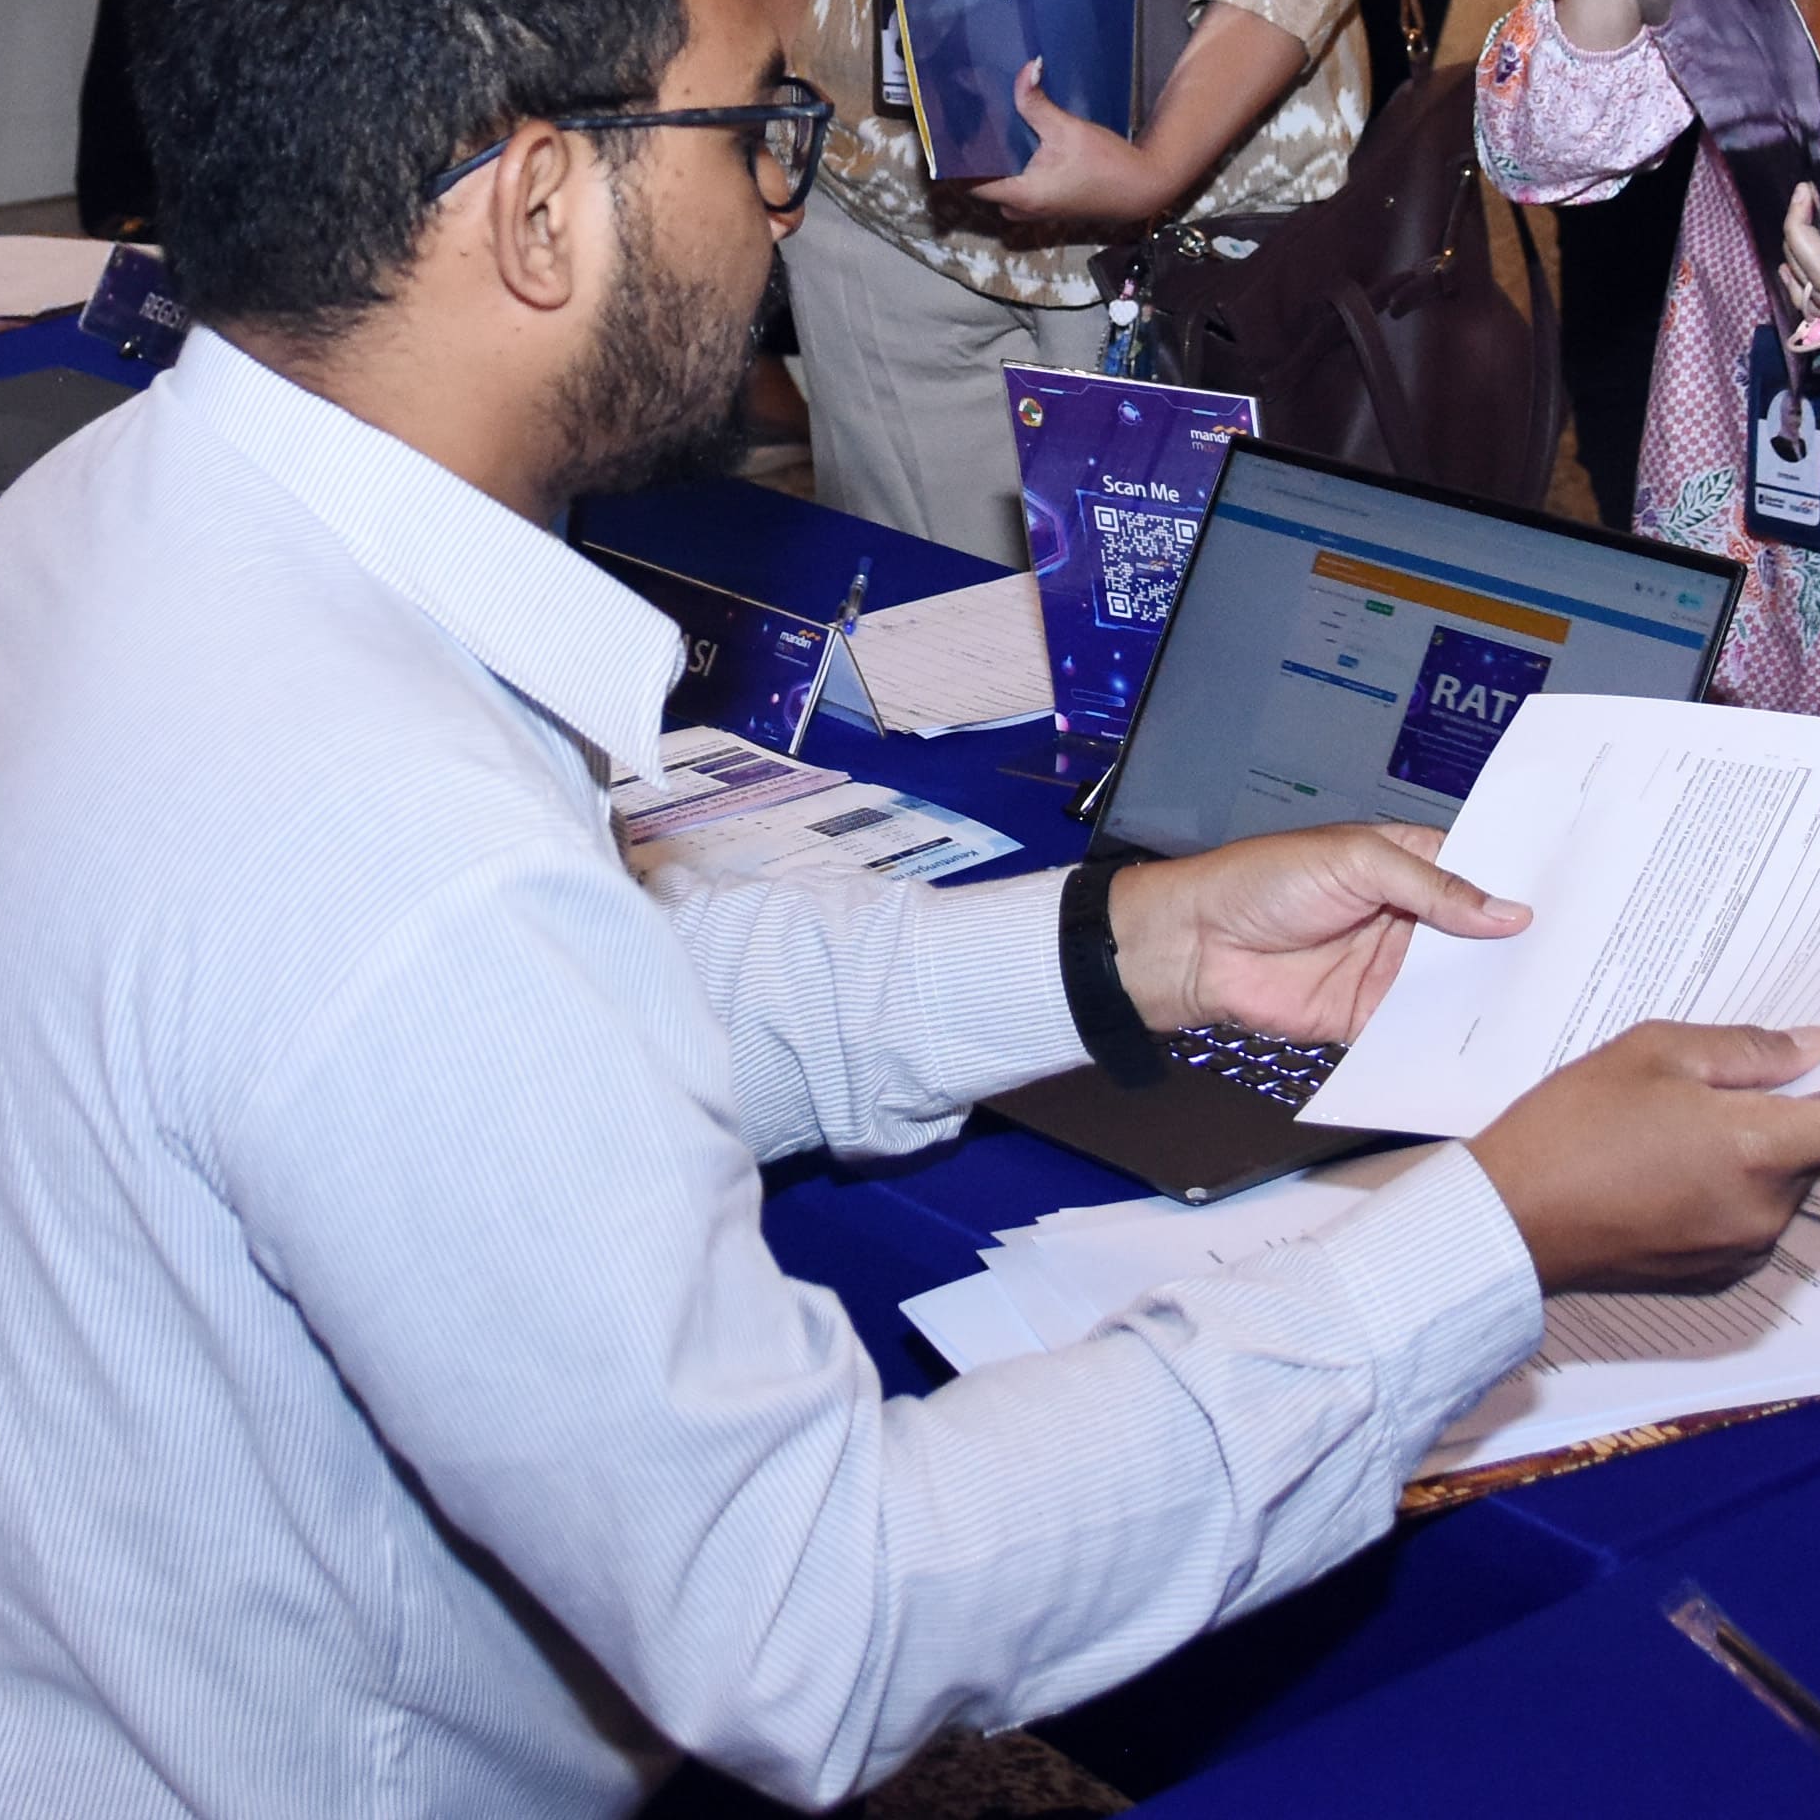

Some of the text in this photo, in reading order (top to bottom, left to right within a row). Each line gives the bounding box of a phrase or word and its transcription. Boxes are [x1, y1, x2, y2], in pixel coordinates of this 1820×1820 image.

[1102, 475, 1180, 503] Scan Me
[1431, 673, 1518, 724] RAT
